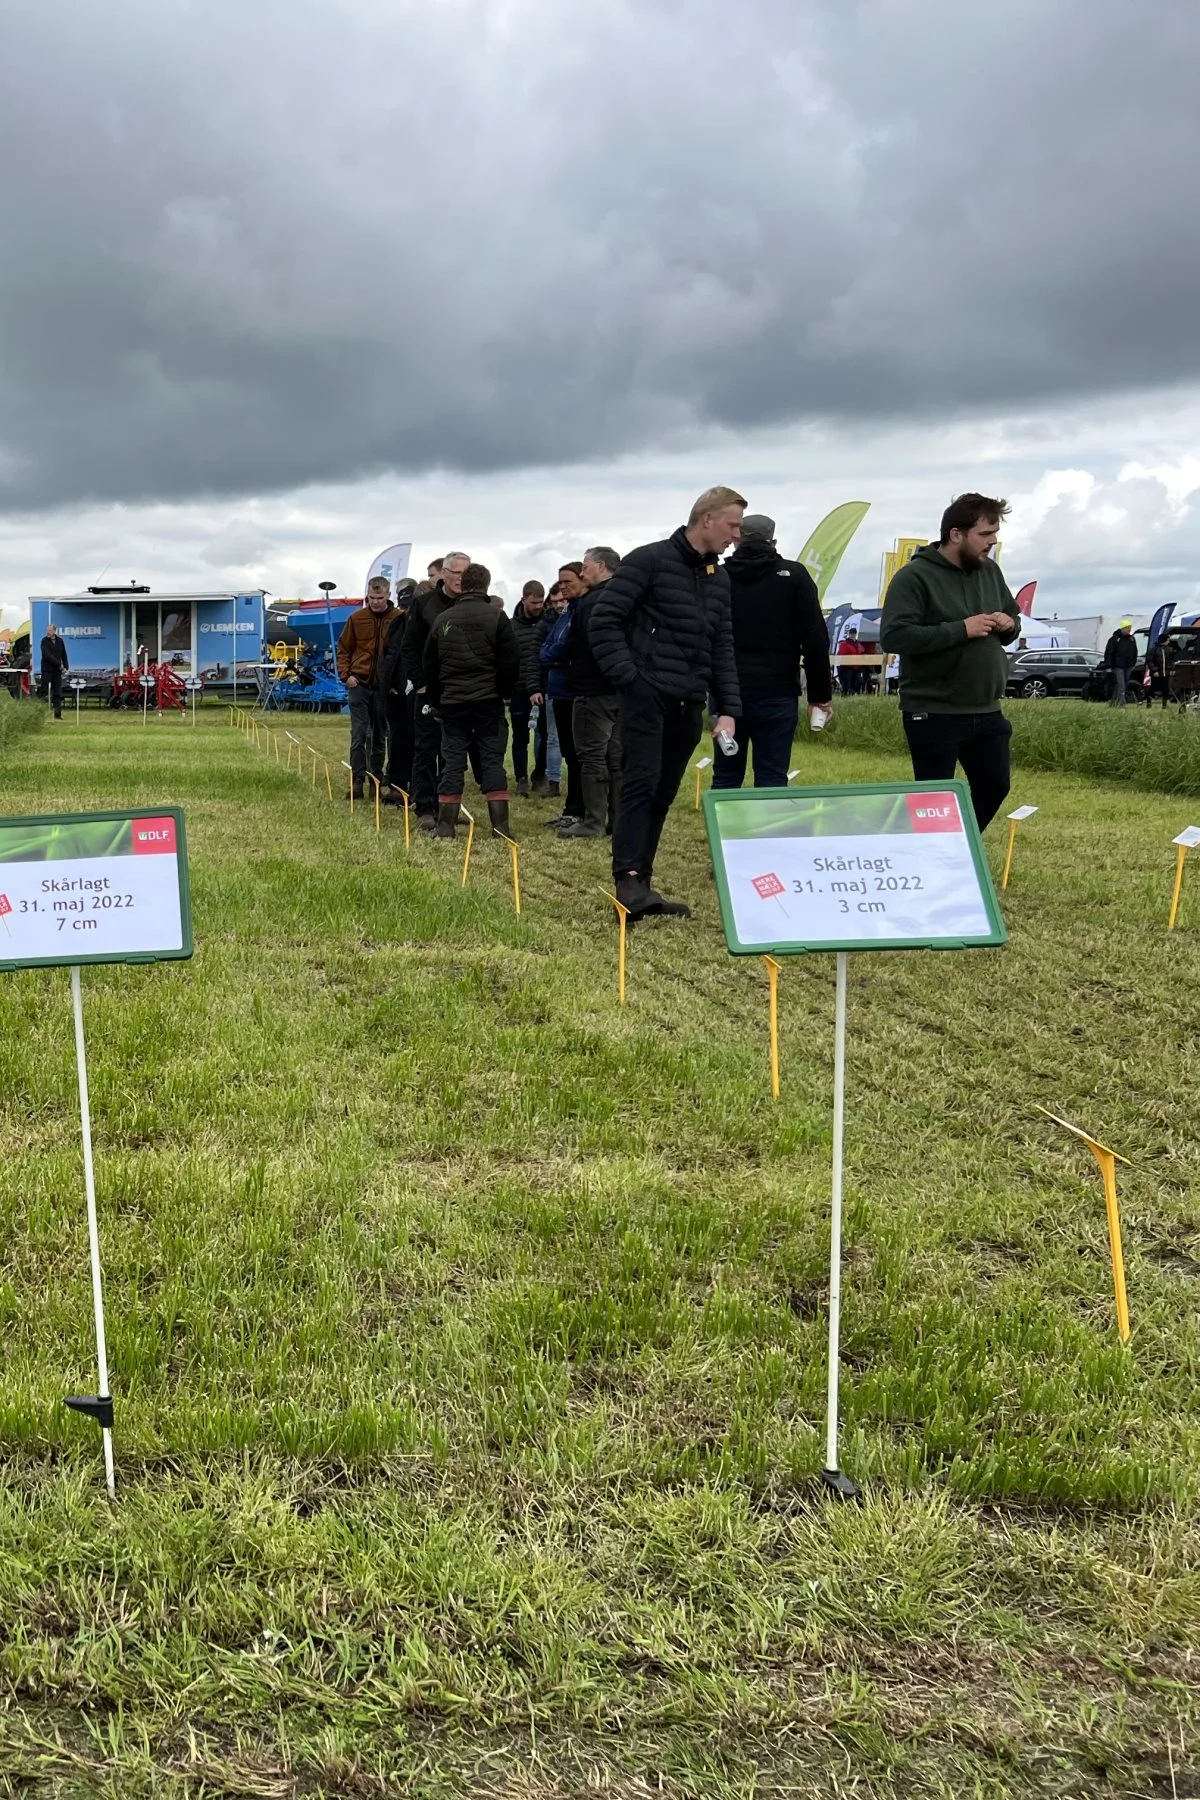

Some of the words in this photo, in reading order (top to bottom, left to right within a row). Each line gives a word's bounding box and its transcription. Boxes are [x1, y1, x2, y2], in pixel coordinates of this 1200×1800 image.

[59, 627, 102, 635] LEMKEN
[211, 623, 254, 632] LEMKEN
[926, 807, 951, 818] DLF
[147, 830, 169, 841] DLF
[813, 856, 893, 872] Skårlagt
[41, 877, 111, 893] Skårlagt
[792, 880, 823, 894] 31.
[831, 878, 868, 895] maj
[874, 876, 924, 891] 2022
[19, 900, 46, 913] 31.
[53, 898, 85, 914] maj
[92, 895, 135, 910] 2022
[839, 900, 850, 914] 3
[857, 901, 886, 913] cm
[56, 918, 67, 931] 7
[72, 920, 98, 931] cm
